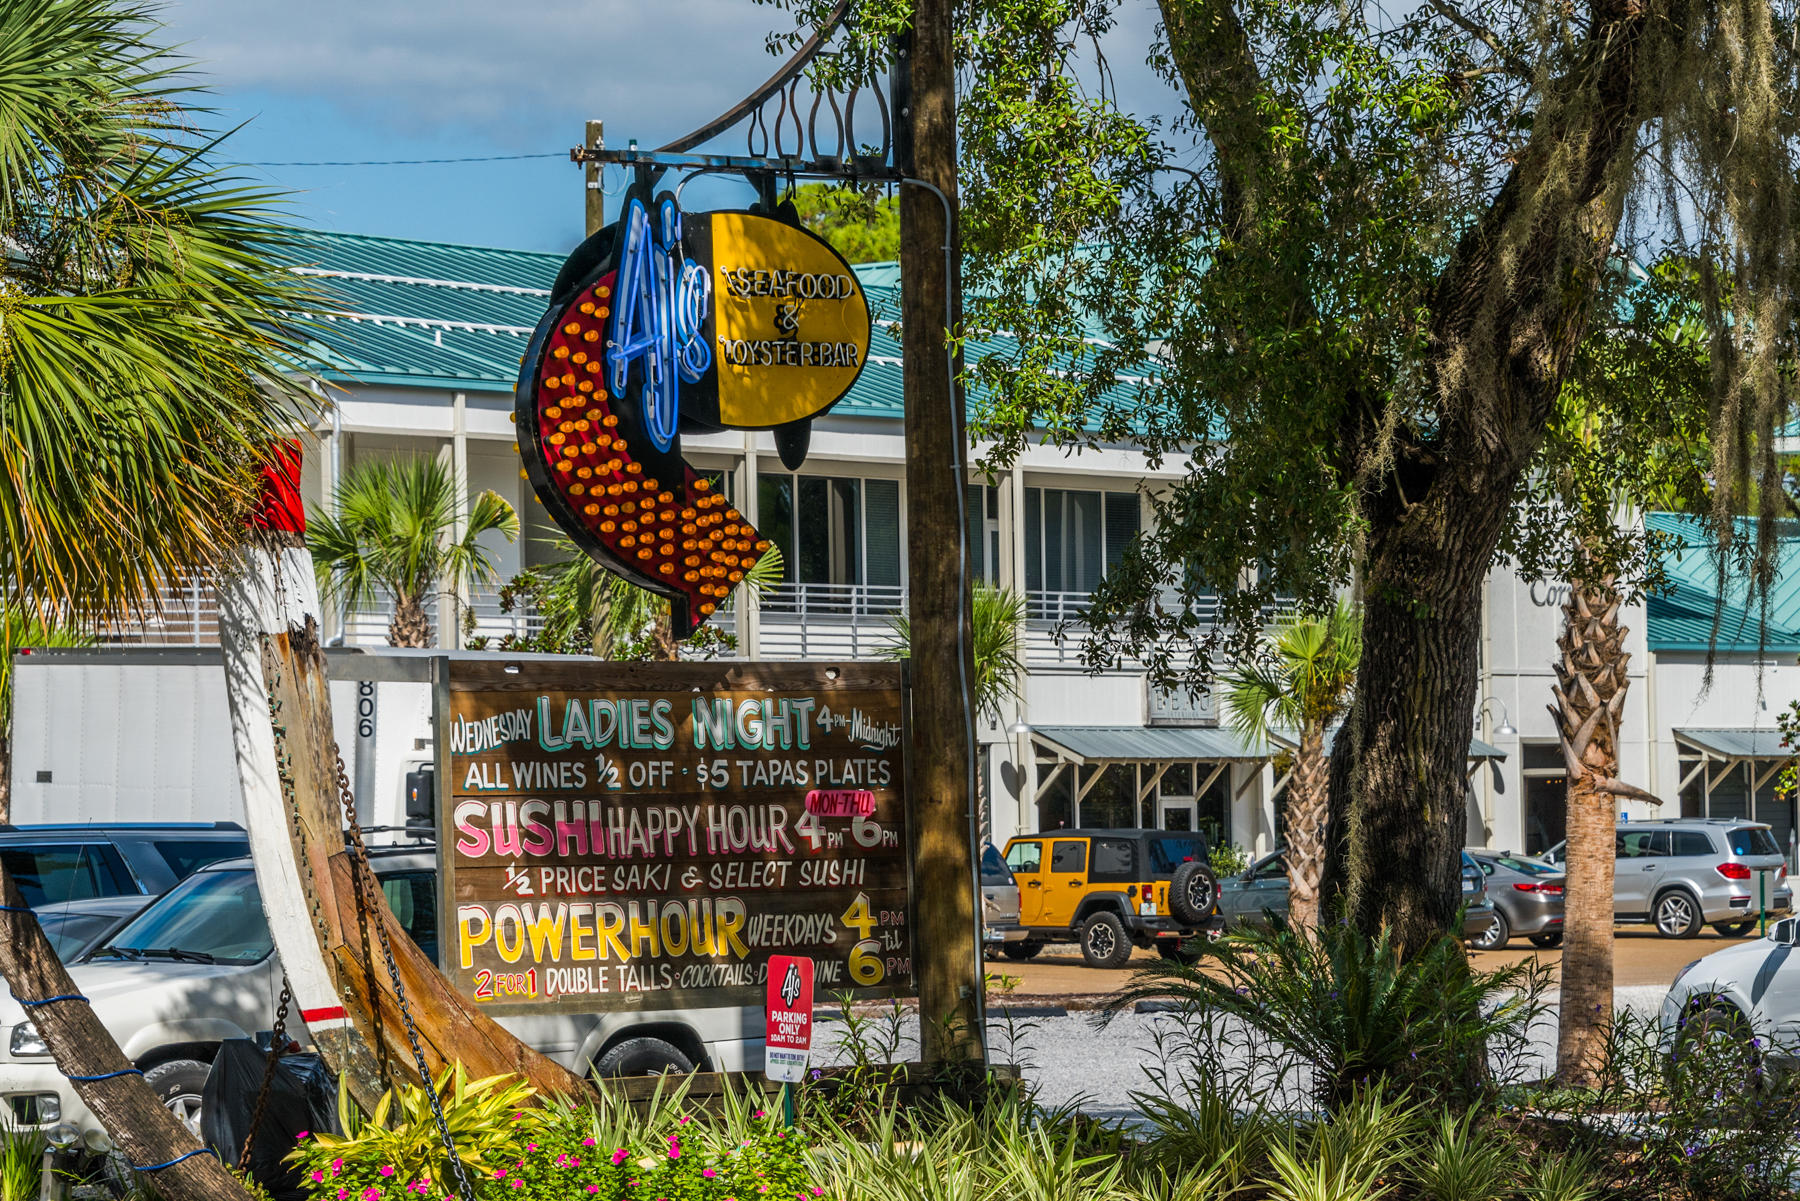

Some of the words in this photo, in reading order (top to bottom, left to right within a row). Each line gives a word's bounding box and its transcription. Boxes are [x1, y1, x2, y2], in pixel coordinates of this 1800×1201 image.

[736, 267, 853, 300] SEAFOOD
[783, 304, 799, 330] &
[732, 340, 814, 367] OYSTER
[820, 342, 859, 367] BAR
[450, 709, 533, 755] WEDNESDAY
[537, 695, 675, 751] LADIES
[692, 696, 815, 751] NIGHT
[464, 761, 509, 790] ALL
[511, 760, 588, 790] WINES
[629, 760, 675, 789] OFF
[696, 757, 730, 791] $5
[736, 758, 810, 787] TAPAS
[815, 758, 891, 787] PLATES
[809, 792, 871, 814] MON-THU
[453, 799, 604, 858] SUSHI
[606, 804, 700, 859] HAPPY
[706, 804, 795, 855] HOUR
[540, 866, 607, 896] PRICE
[612, 864, 671, 892] SAKI
[681, 865, 703, 890] &
[708, 861, 793, 891] SELECT
[799, 858, 866, 888] SUSHI
[748, 913, 838, 948] WEEKDAYS
[879, 929, 903, 952] til
[474, 968, 494, 1001] 2
[495, 972, 526, 997] FOR
[526, 966, 538, 998] 1
[546, 966, 609, 996] DOUBLE
[616, 963, 673, 993] TALLS
[680, 962, 754, 989] COCKTAILS
[771, 1010, 808, 1025] PARKING
[778, 1022, 801, 1036] ONLY
[786, 1036, 795, 1044] TO
[795, 1036, 807, 1045] 2AM
